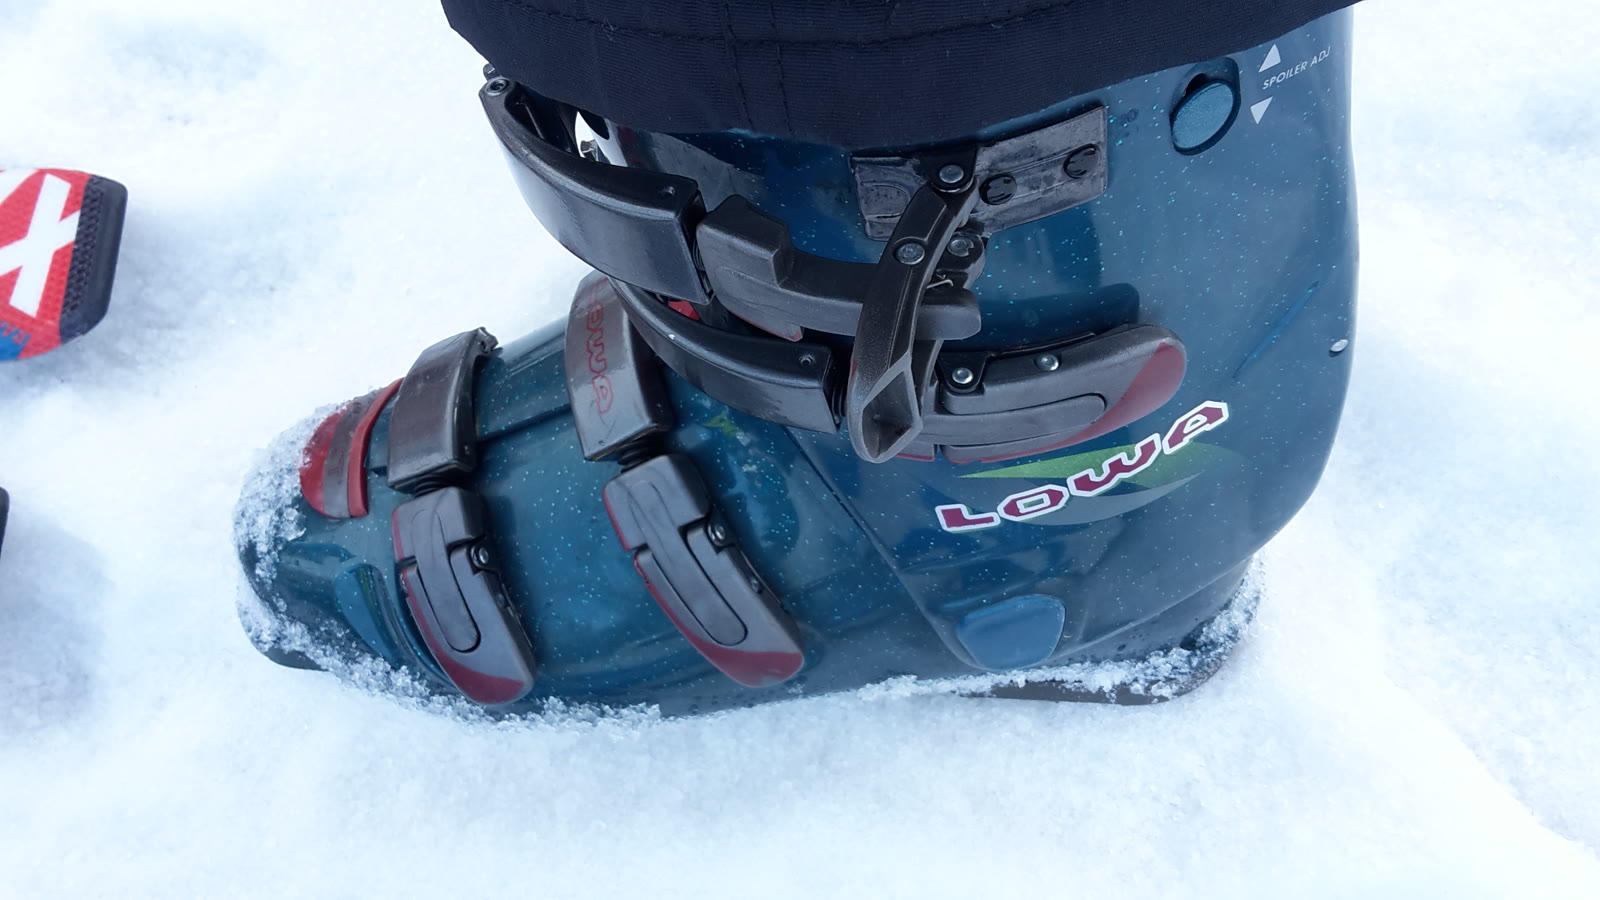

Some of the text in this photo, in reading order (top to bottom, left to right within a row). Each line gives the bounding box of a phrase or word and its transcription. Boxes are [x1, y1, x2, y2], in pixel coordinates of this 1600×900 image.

[1262, 46, 1331, 90] SPOILER ADJ
[935, 400, 1229, 533] LOWA
